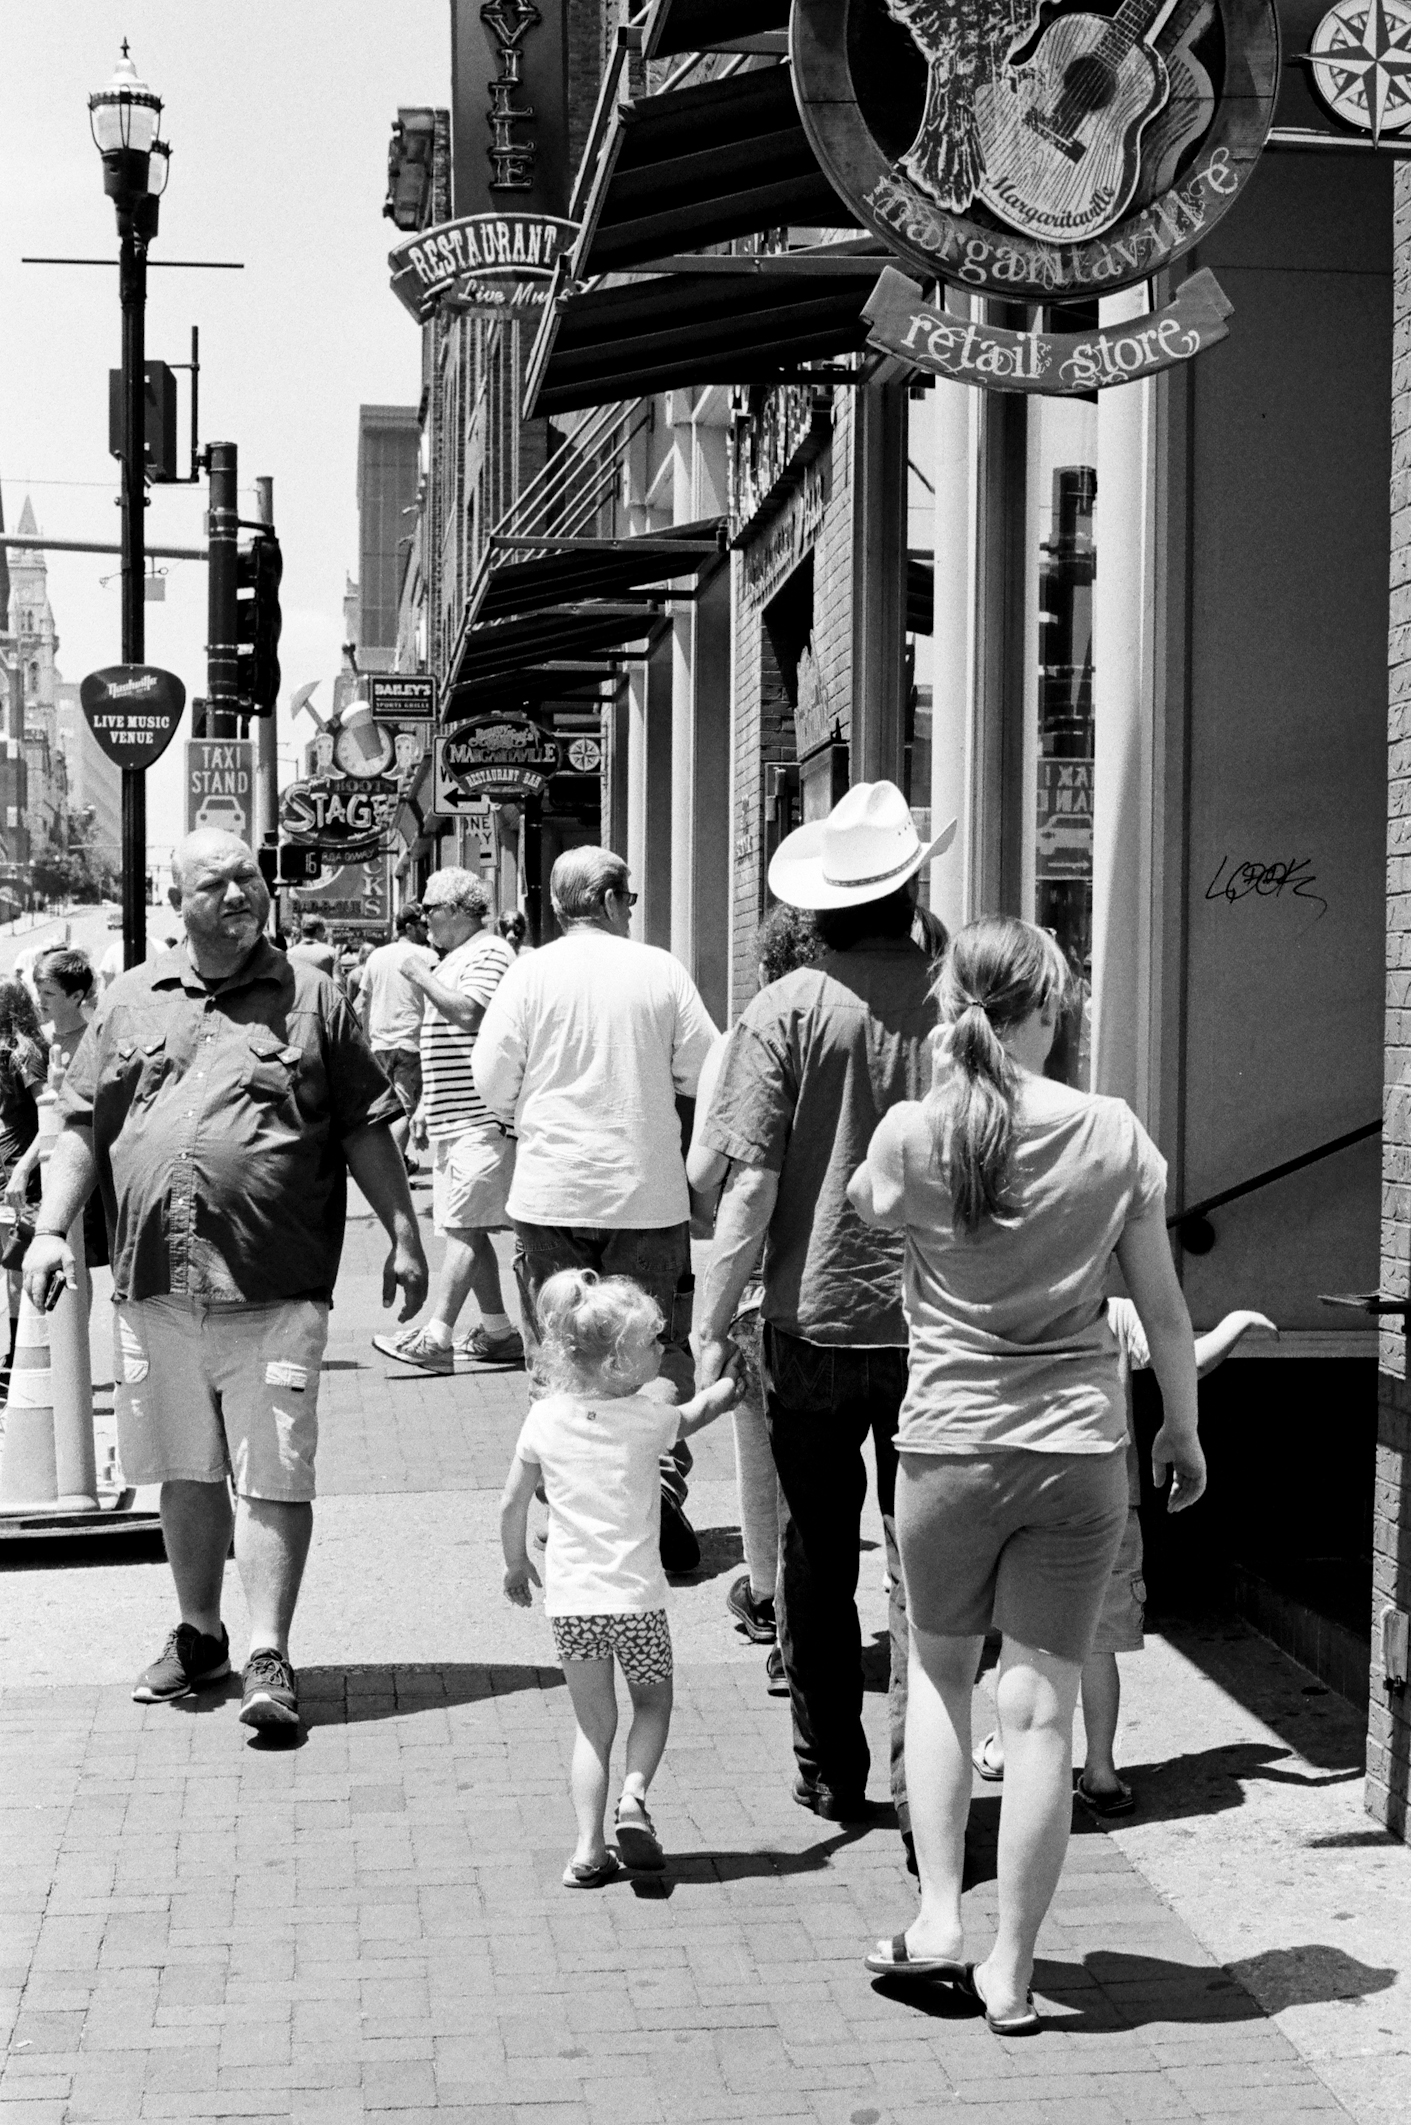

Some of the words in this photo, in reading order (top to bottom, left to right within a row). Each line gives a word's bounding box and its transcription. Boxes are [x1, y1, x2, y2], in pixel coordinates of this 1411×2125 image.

[482, 0, 541, 188] VILLE
[408, 221, 557, 284] RESTAURANT
[457, 278, 506, 304] Live
[901, 314, 1051, 384] retail
[1059, 317, 1200, 389] store
[374, 683, 432, 696] BAILEY'S
[93, 715, 125, 728] LIVE
[127, 715, 171, 729] MUSIC
[110, 730, 154, 744] VENUE
[201, 746, 241, 769] TAXI
[191, 770, 249, 793] STAND
[464, 768, 520, 788] RESTAURANT
